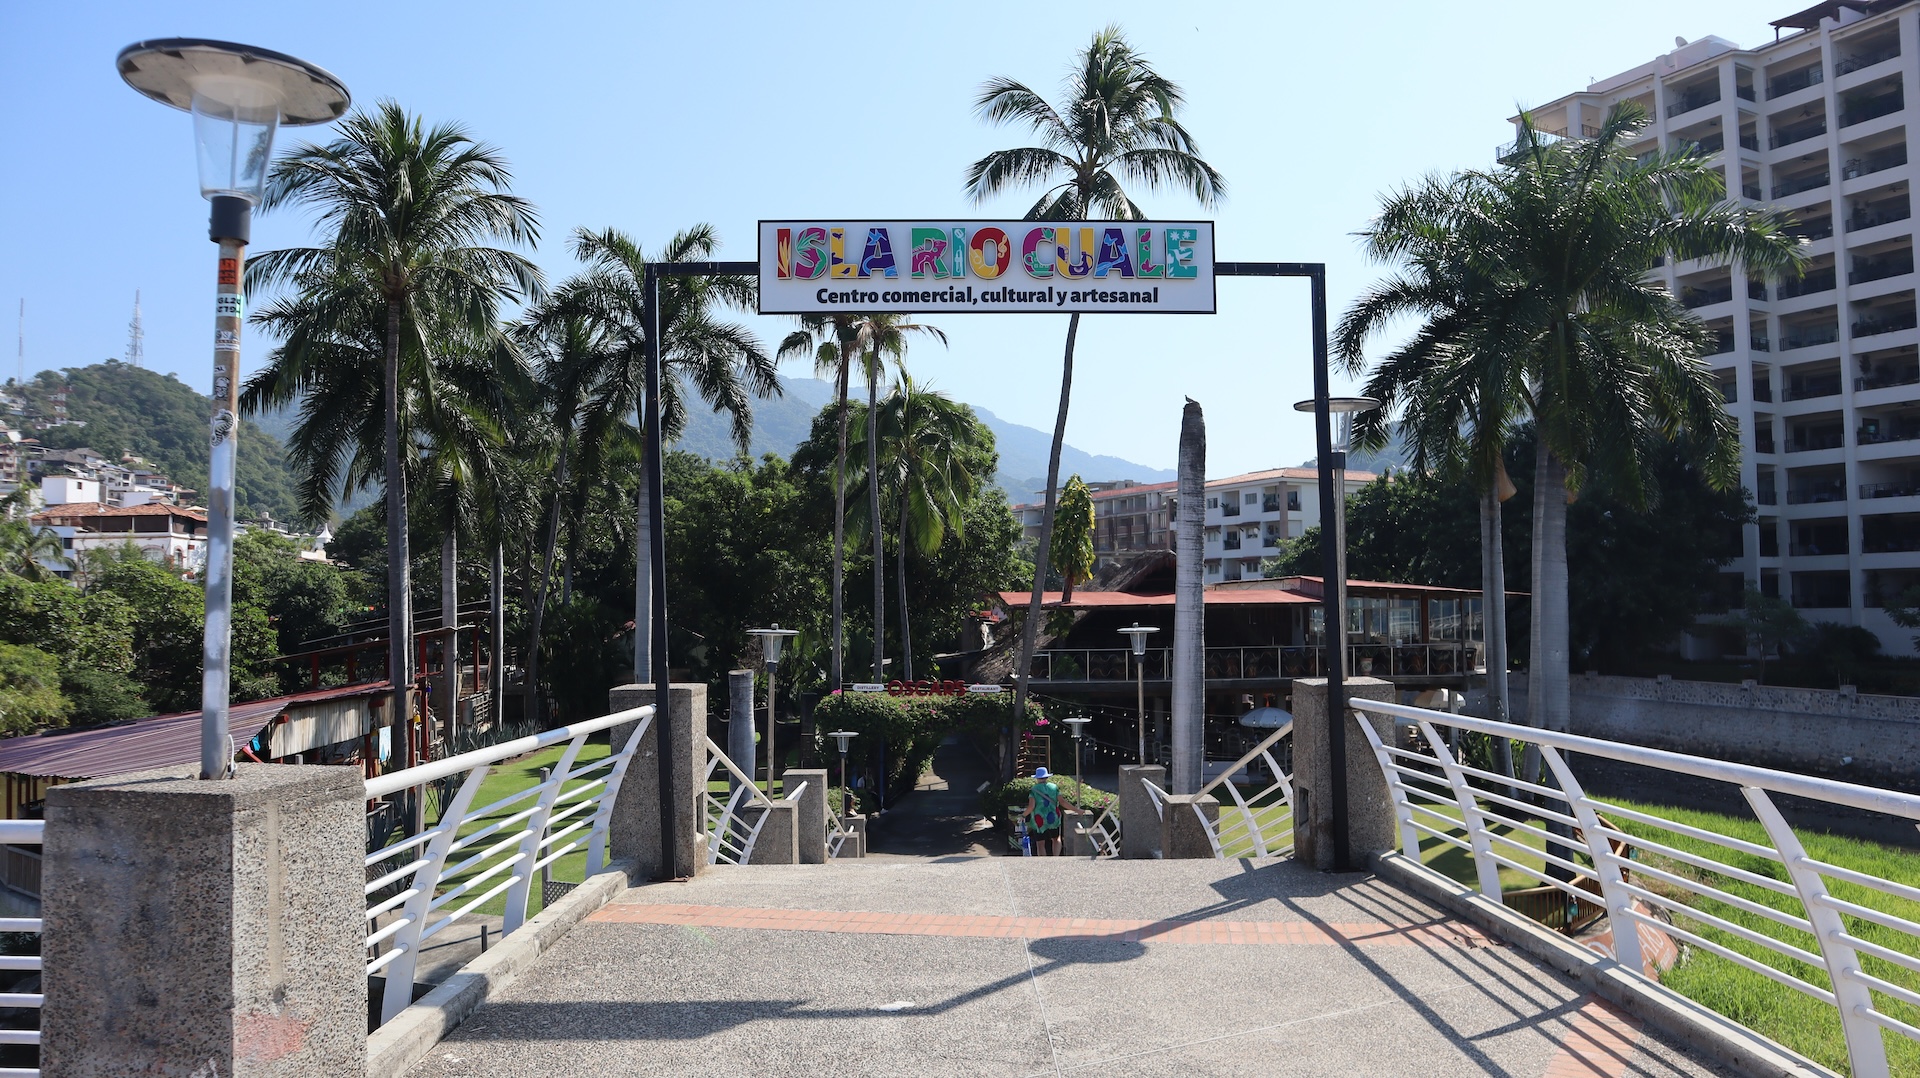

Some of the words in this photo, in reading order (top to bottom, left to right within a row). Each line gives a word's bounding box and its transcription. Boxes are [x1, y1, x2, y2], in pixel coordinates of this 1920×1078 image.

[777, 227, 899, 280] ISLA
[911, 226, 1011, 280] RIO
[1021, 227, 1199, 280] CUALE
[816, 288, 879, 304] Centro
[881, 286, 978, 305] comercial,
[980, 287, 1053, 304] cultural
[1056, 290, 1067, 307] y
[1070, 287, 1159, 304] artesanal
